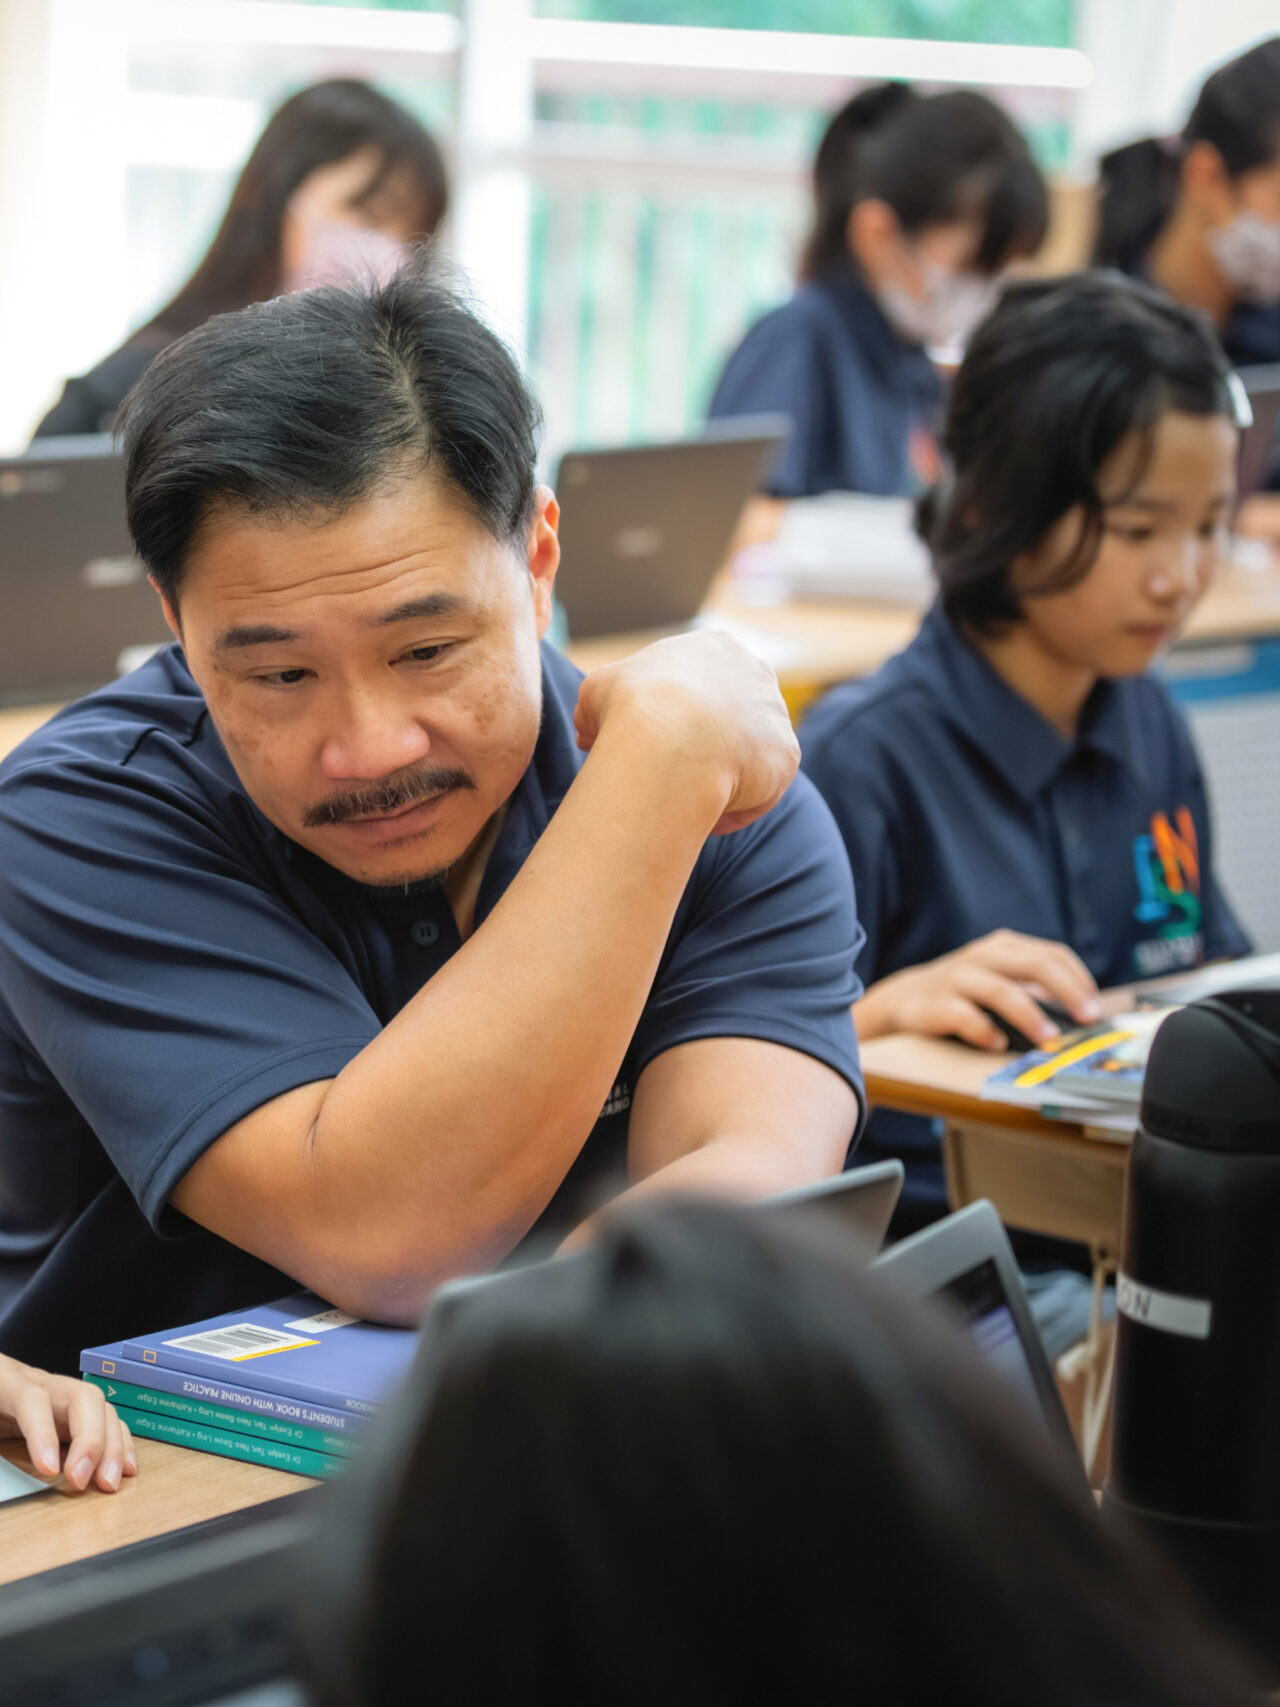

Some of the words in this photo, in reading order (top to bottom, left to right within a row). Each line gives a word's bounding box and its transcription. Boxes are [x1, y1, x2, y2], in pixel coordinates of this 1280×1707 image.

[183, 1381, 219, 1398] PRACTICE
[137, 1393, 157, 1405] Edgar
[221, 1390, 252, 1405] ONLINE
[159, 1398, 193, 1413] Katharine
[253, 1397, 274, 1411] WITH
[199, 1406, 214, 1418] Ling
[276, 1405, 300, 1417] BOOK
[135, 1418, 156, 1430] Edgar
[236, 1416, 251, 1427] Neo
[302, 1409, 345, 1428] STUDENT'S
[158, 1423, 191, 1438] Katharine
[253, 1419, 267, 1431] Tan,
[269, 1423, 293, 1437] Evelyn
[197, 1431, 212, 1443] Ling
[294, 1430, 303, 1439] Dr
[235, 1441, 250, 1453] Neo
[251, 1445, 266, 1457] Tan,
[267, 1449, 291, 1462] Evelyn
[292, 1456, 301, 1464] Dr
